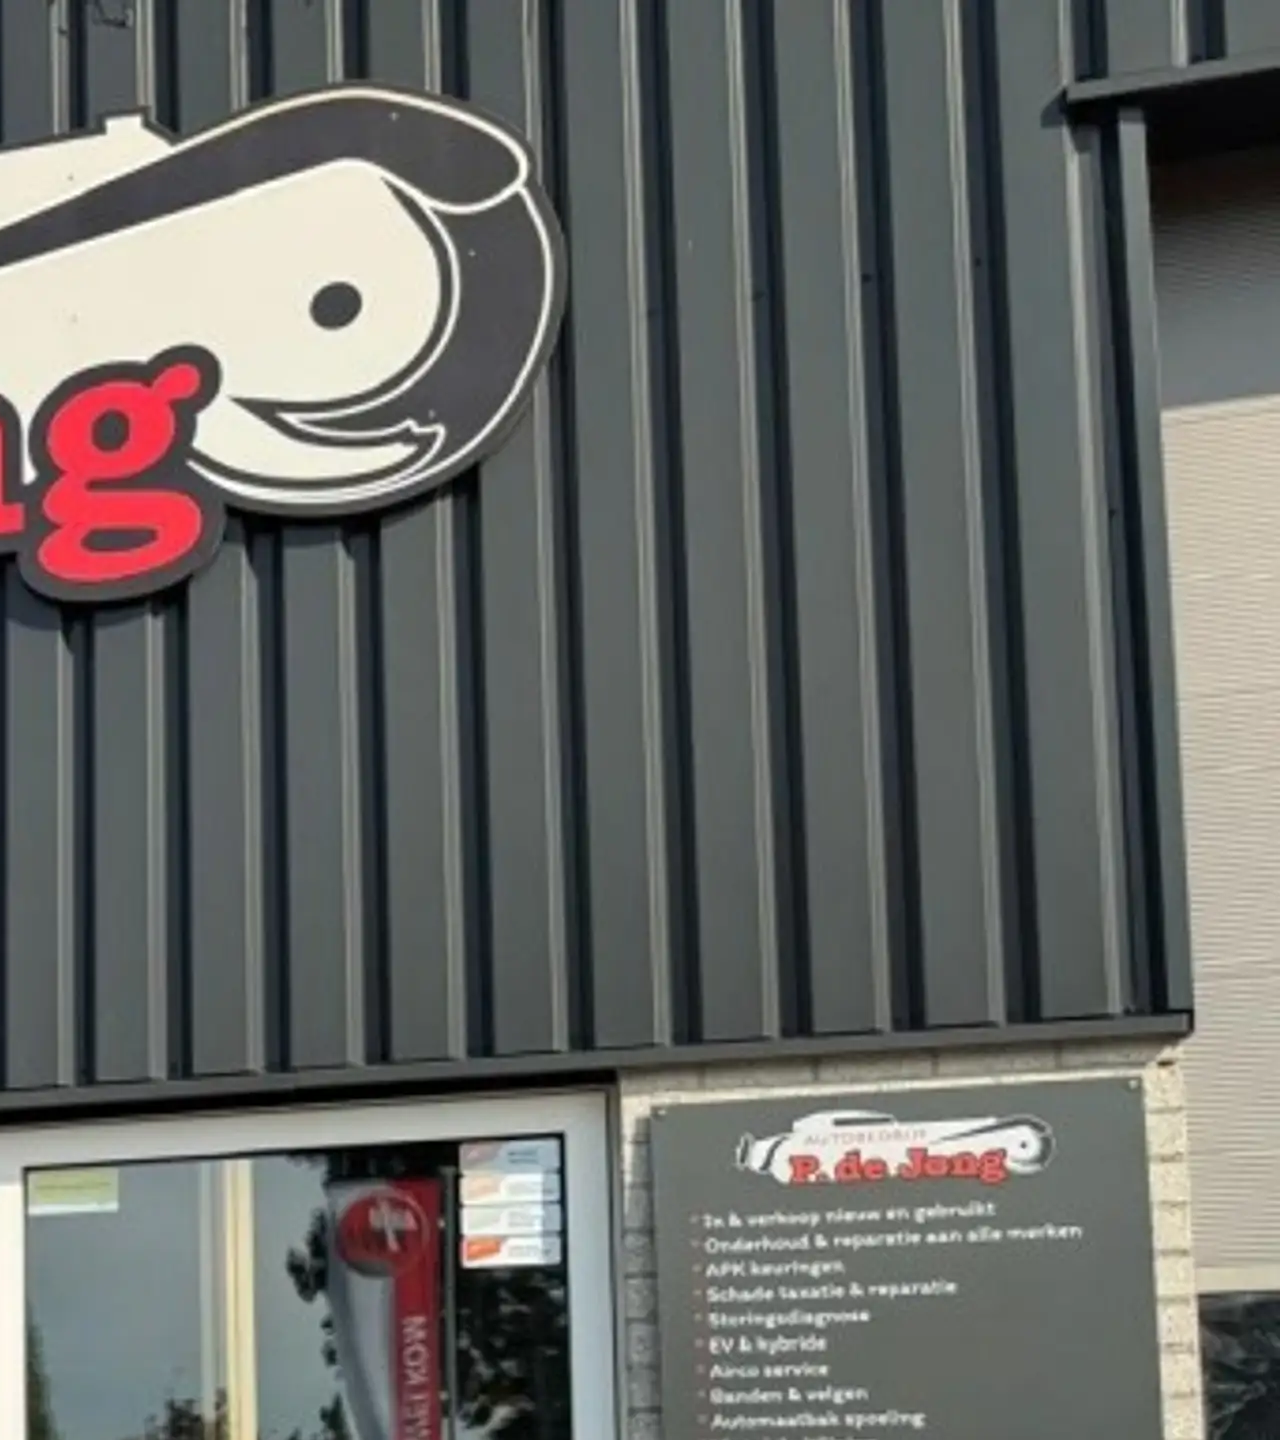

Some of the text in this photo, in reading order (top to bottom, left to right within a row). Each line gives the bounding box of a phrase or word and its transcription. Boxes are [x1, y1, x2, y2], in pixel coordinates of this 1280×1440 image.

[835, 1150, 887, 1182] de
[899, 1147, 1008, 1184] Jong
[747, 1209, 820, 1228] verkoop
[914, 1200, 996, 1224] gebruikt
[704, 1234, 810, 1253] Onderhoud
[814, 1233, 828, 1248] &
[833, 1228, 922, 1251] reparatie
[925, 1229, 963, 1243] aan
[705, 1259, 845, 1279] APK keuringen
[706, 1278, 957, 1303] Schade taxatie & reparatie
[709, 1333, 827, 1355] EV & hybride
[709, 1361, 829, 1379] Airco service
[788, 1386, 802, 1401] &
[806, 1384, 869, 1404] velgen
